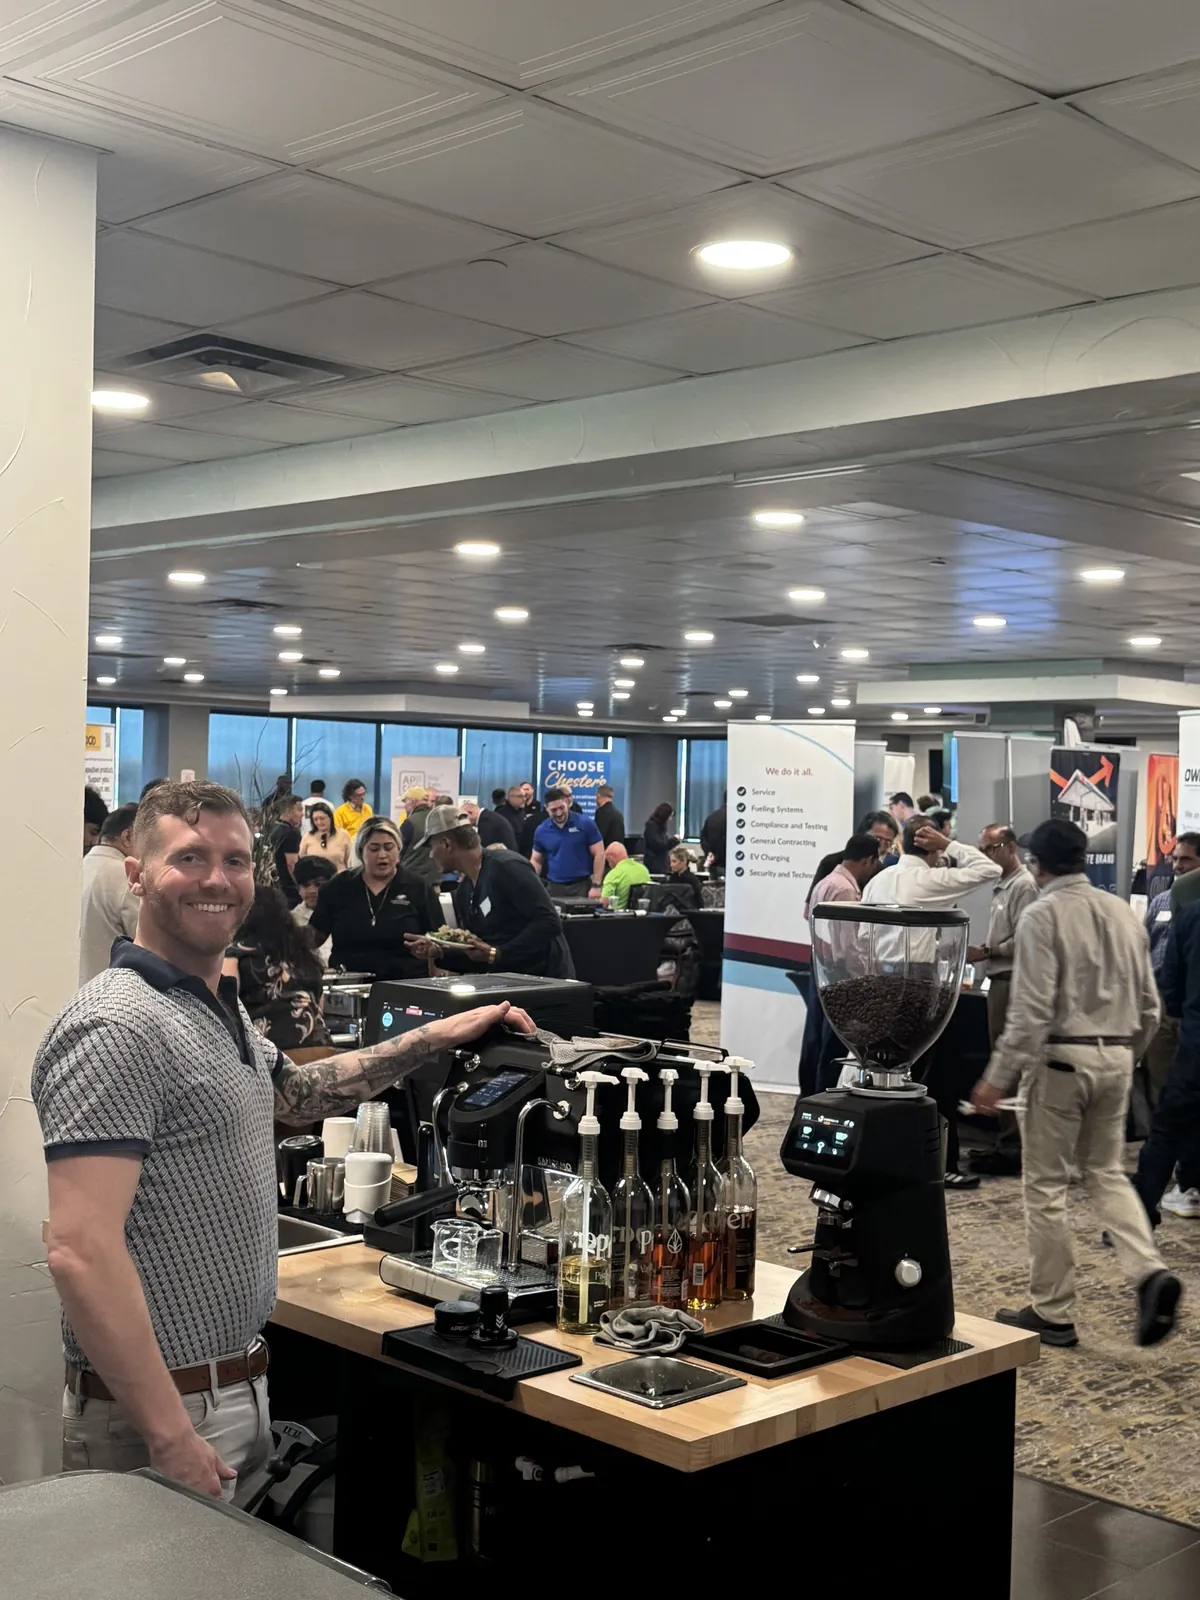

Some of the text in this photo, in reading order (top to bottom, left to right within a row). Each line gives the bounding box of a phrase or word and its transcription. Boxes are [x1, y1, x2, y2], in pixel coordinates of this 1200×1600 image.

[548, 760, 605, 772] CHOOSE
[765, 767, 813, 776] We do it all.
[544, 771, 607, 788] Chester's
[751, 805, 804, 814] Fueling Systems
[750, 820, 789, 829] Compliance
[804, 822, 828, 831] Testing
[750, 837, 817, 847] General Contracting
[749, 853, 790, 863] EV Charging
[1095, 853, 1115, 864] BRAND
[749, 869, 777, 878] Security
